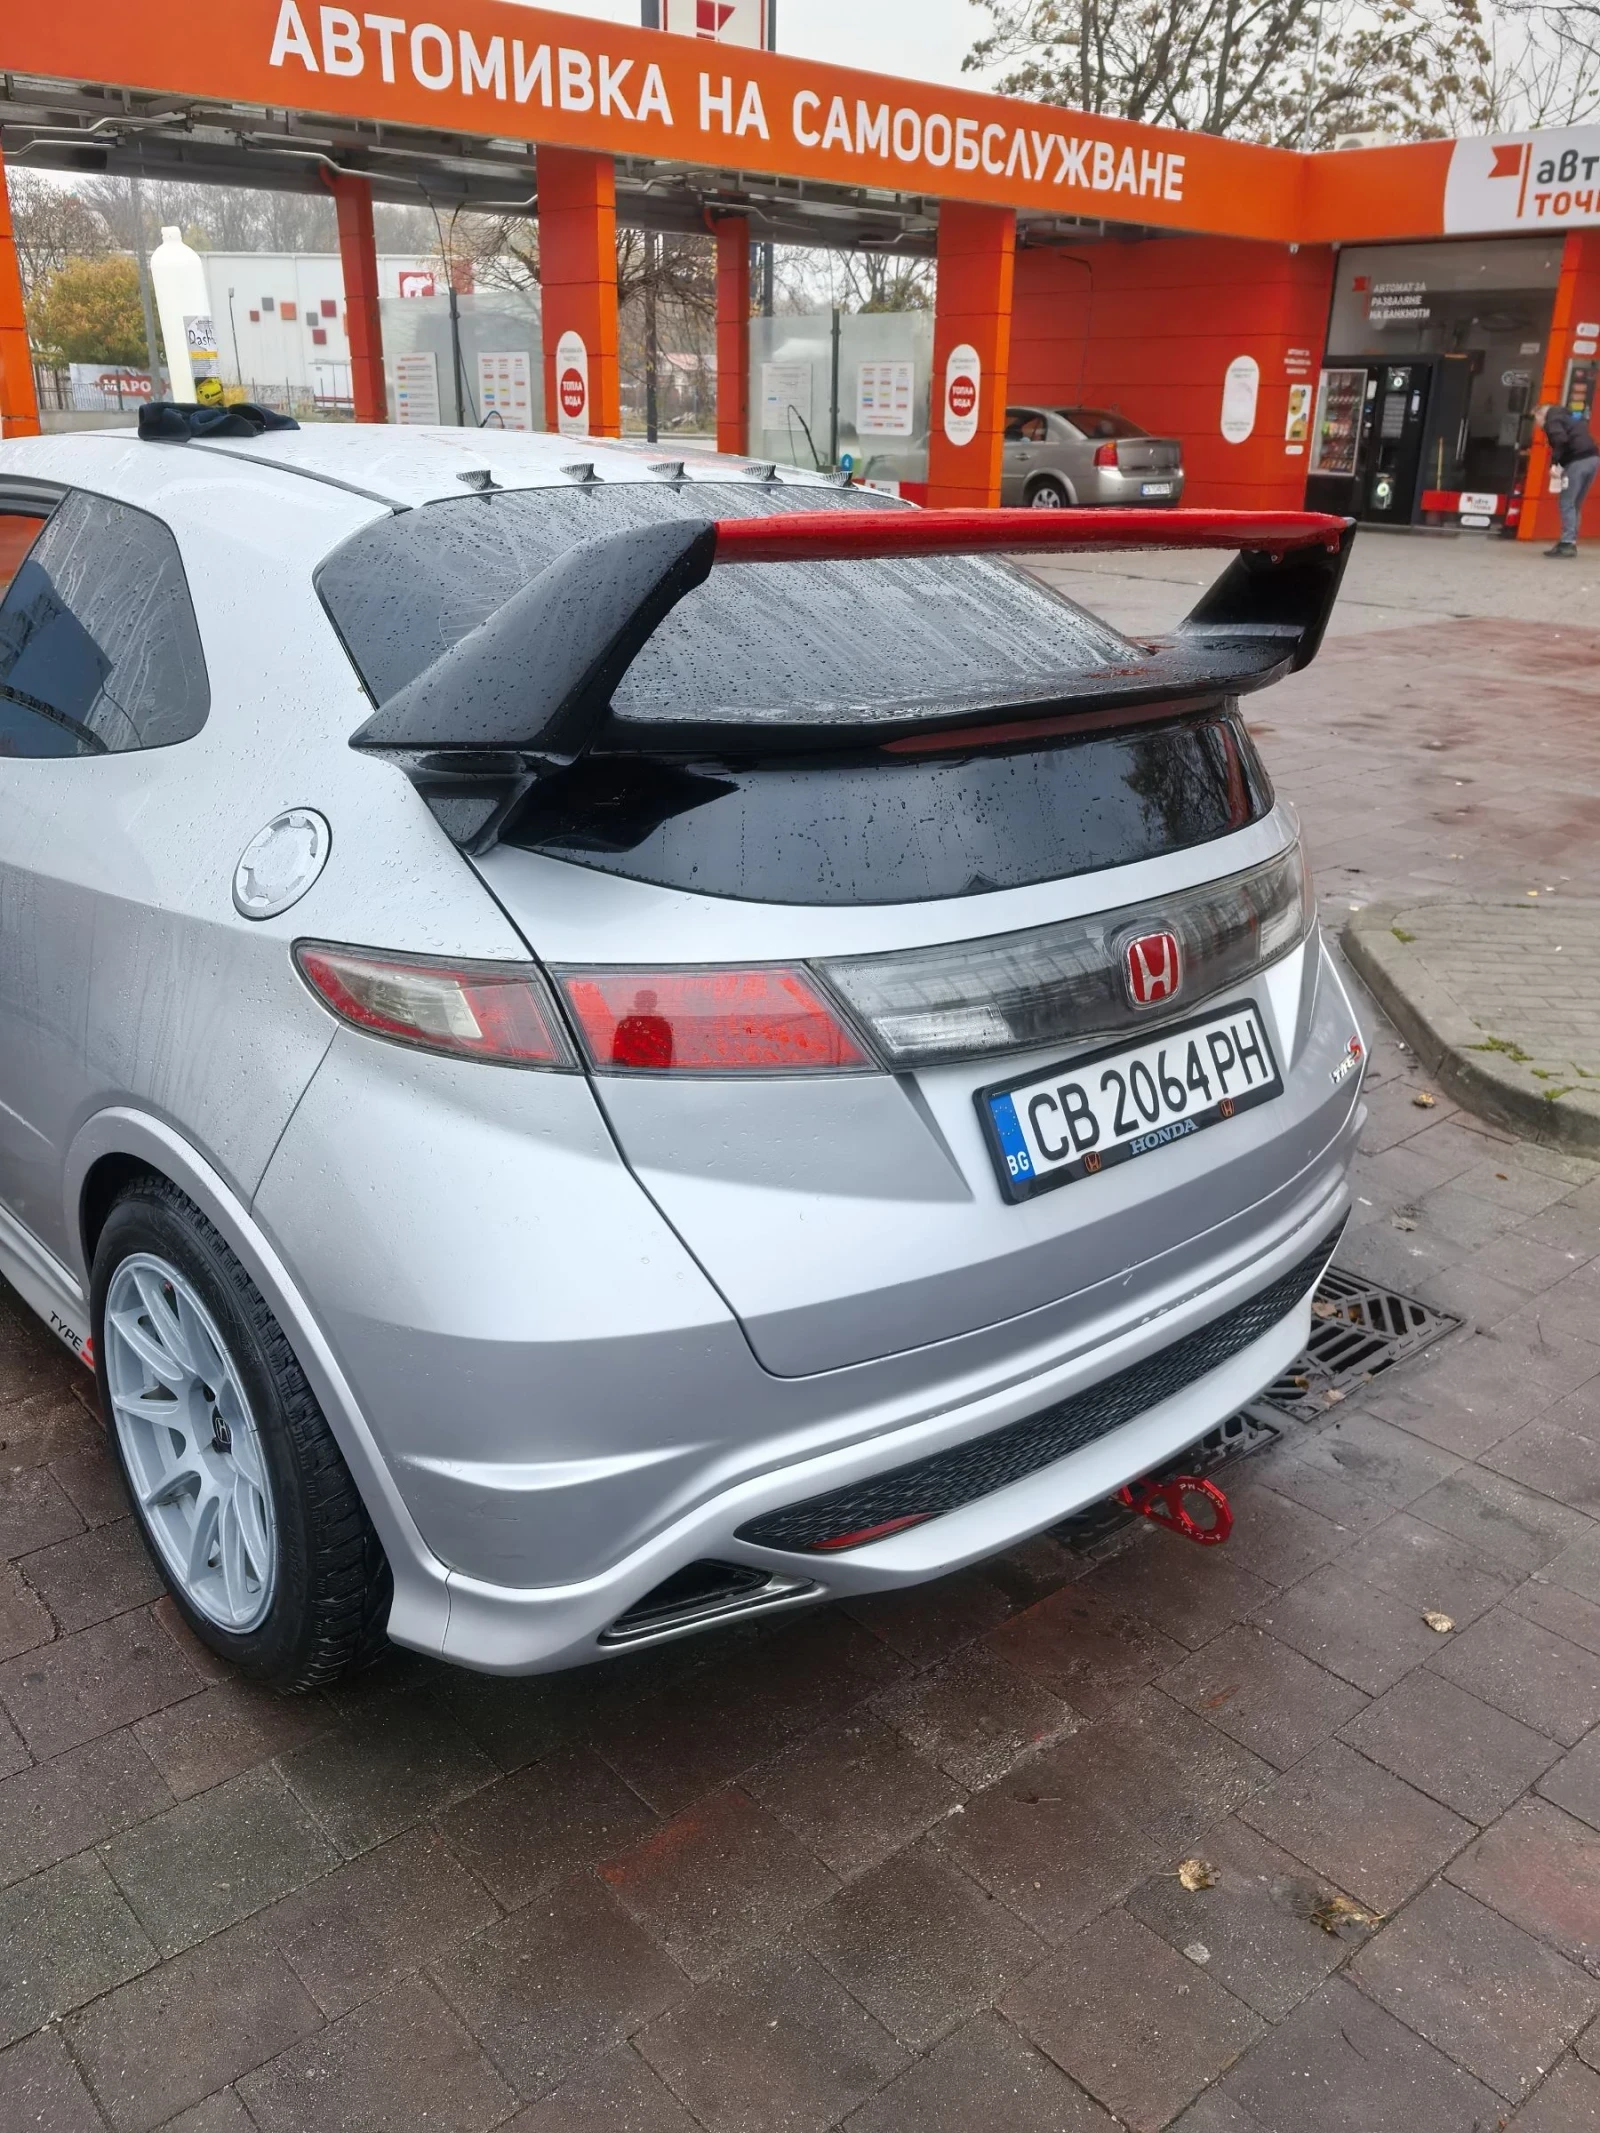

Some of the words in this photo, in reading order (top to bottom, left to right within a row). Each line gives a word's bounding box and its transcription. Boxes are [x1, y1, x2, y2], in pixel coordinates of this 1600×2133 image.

[269, 0, 673, 126] АВТОМИВКА
[699, 72, 769, 139] НА
[793, 91, 1186, 201] САМООБСЛУЖВАНЕ
[1130, 1118, 1199, 1155] HONDA
[1006, 1151, 1031, 1177] BG
[50, 1310, 83, 1351] TYPE
